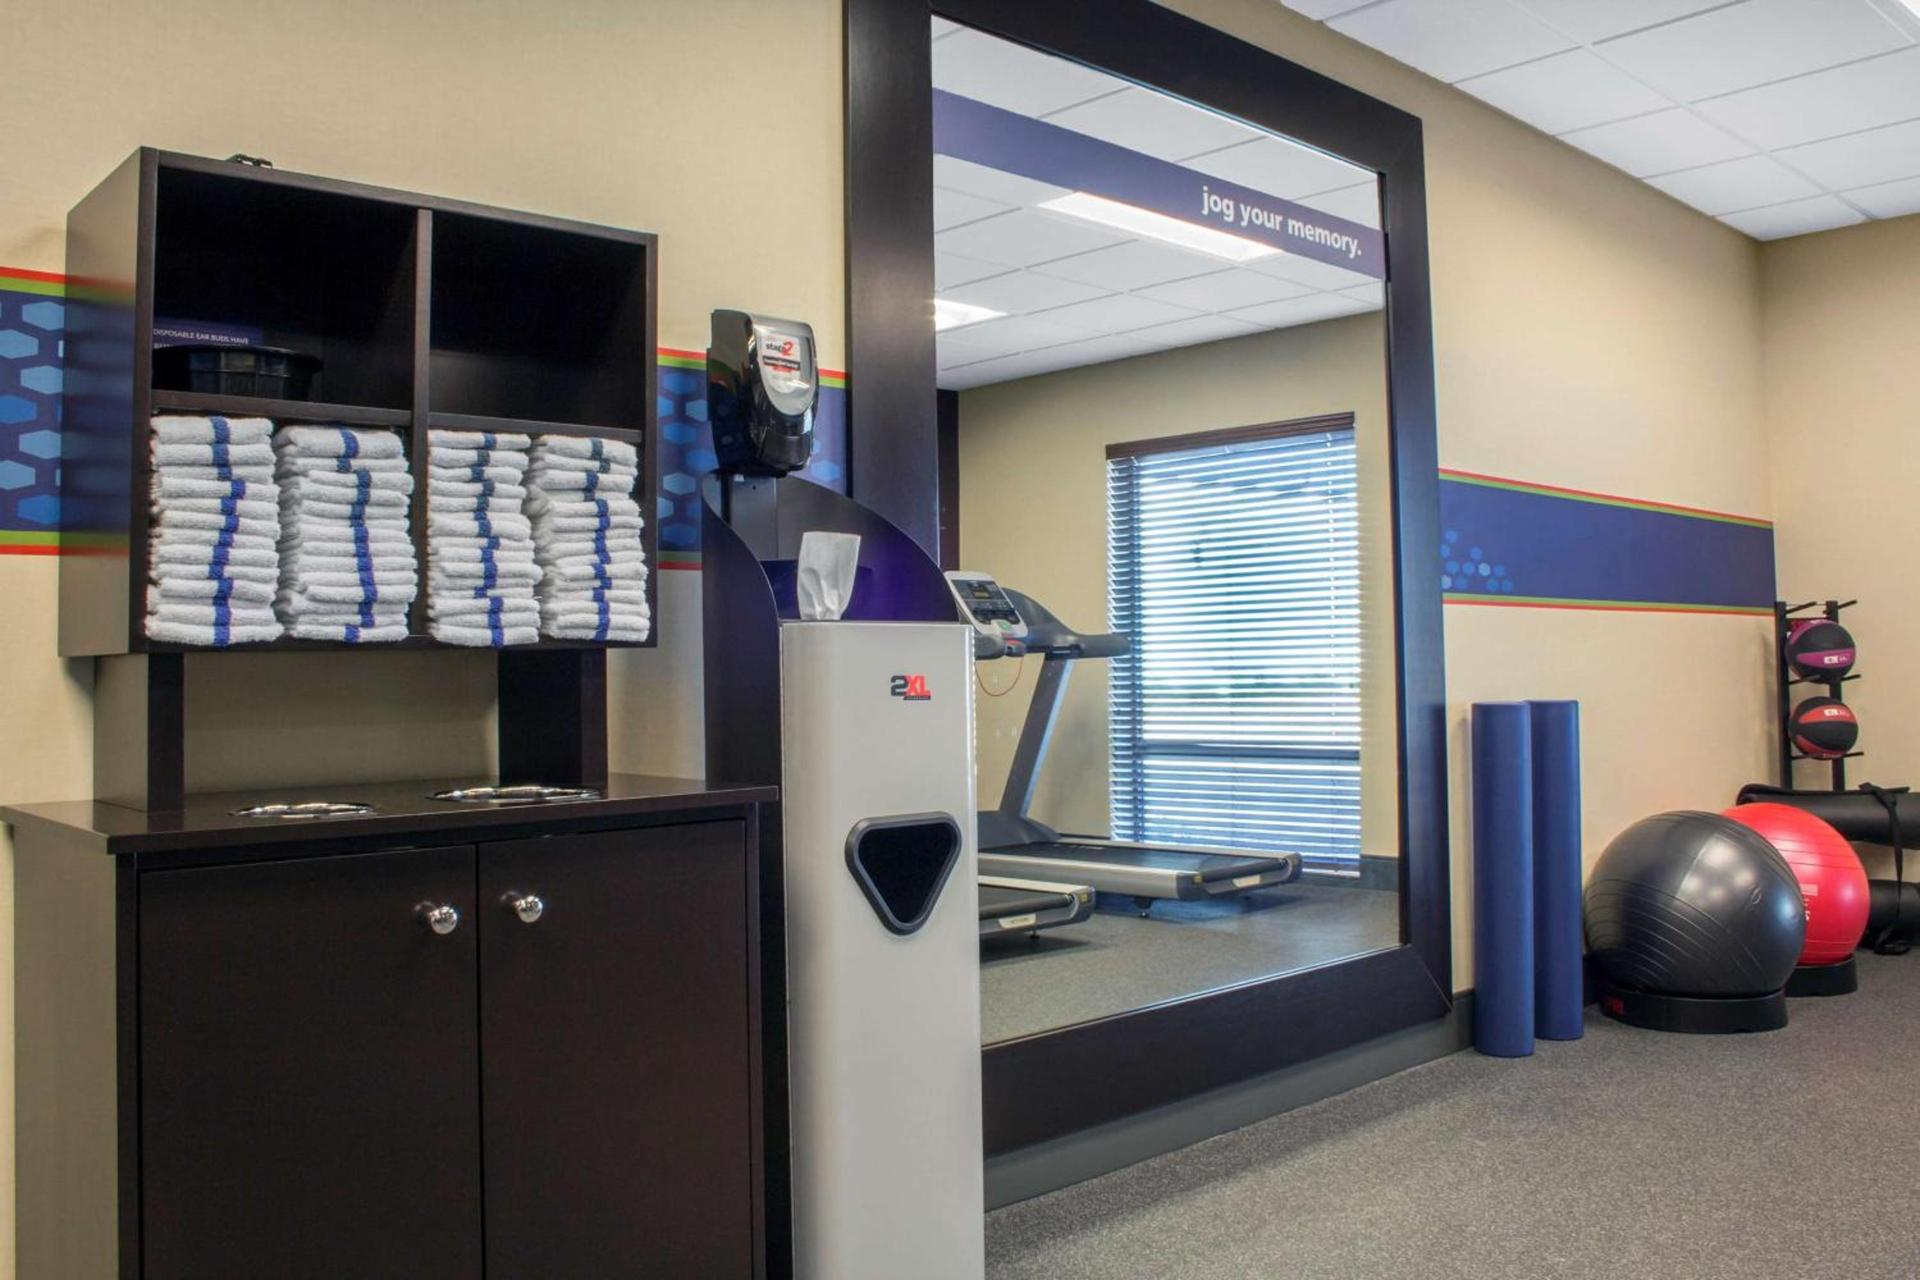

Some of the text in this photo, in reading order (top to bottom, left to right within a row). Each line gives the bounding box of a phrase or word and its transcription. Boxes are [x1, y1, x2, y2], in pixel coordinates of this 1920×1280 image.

[1202, 186, 1362, 259] jog your memory.
[153, 328, 195, 339] DISPOSABLE
[196, 332, 210, 340] EAR
[211, 334, 229, 343] BUDS
[890, 675, 931, 697] 2XL
